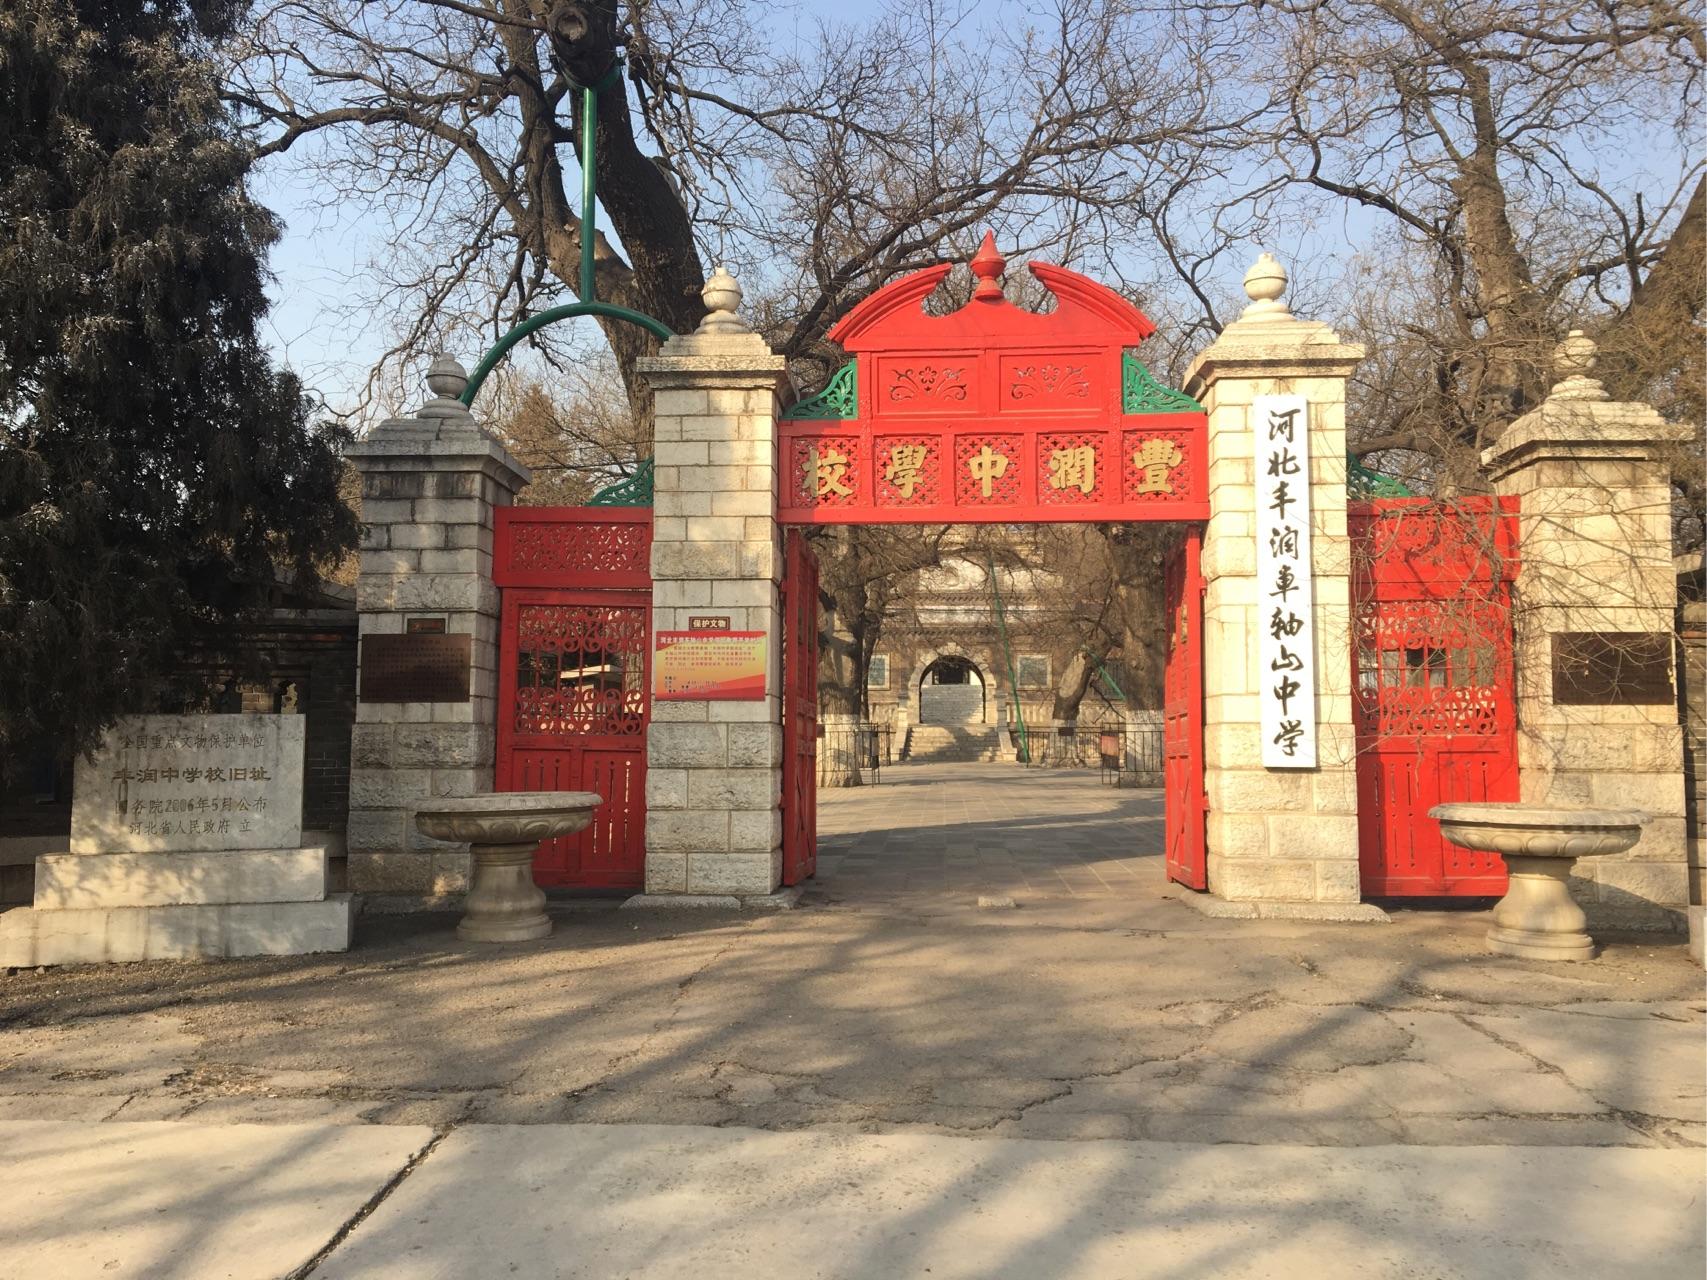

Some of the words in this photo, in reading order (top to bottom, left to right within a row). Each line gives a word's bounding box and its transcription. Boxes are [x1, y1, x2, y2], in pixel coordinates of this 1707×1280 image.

[692, 619, 727, 628] 保护文物
[120, 734, 265, 750] 全国重点文物保护单位
[111, 766, 272, 784] 丰润中学校旧址
[128, 818, 231, 836] 河北省人民政府
[239, 818, 252, 833] 立
